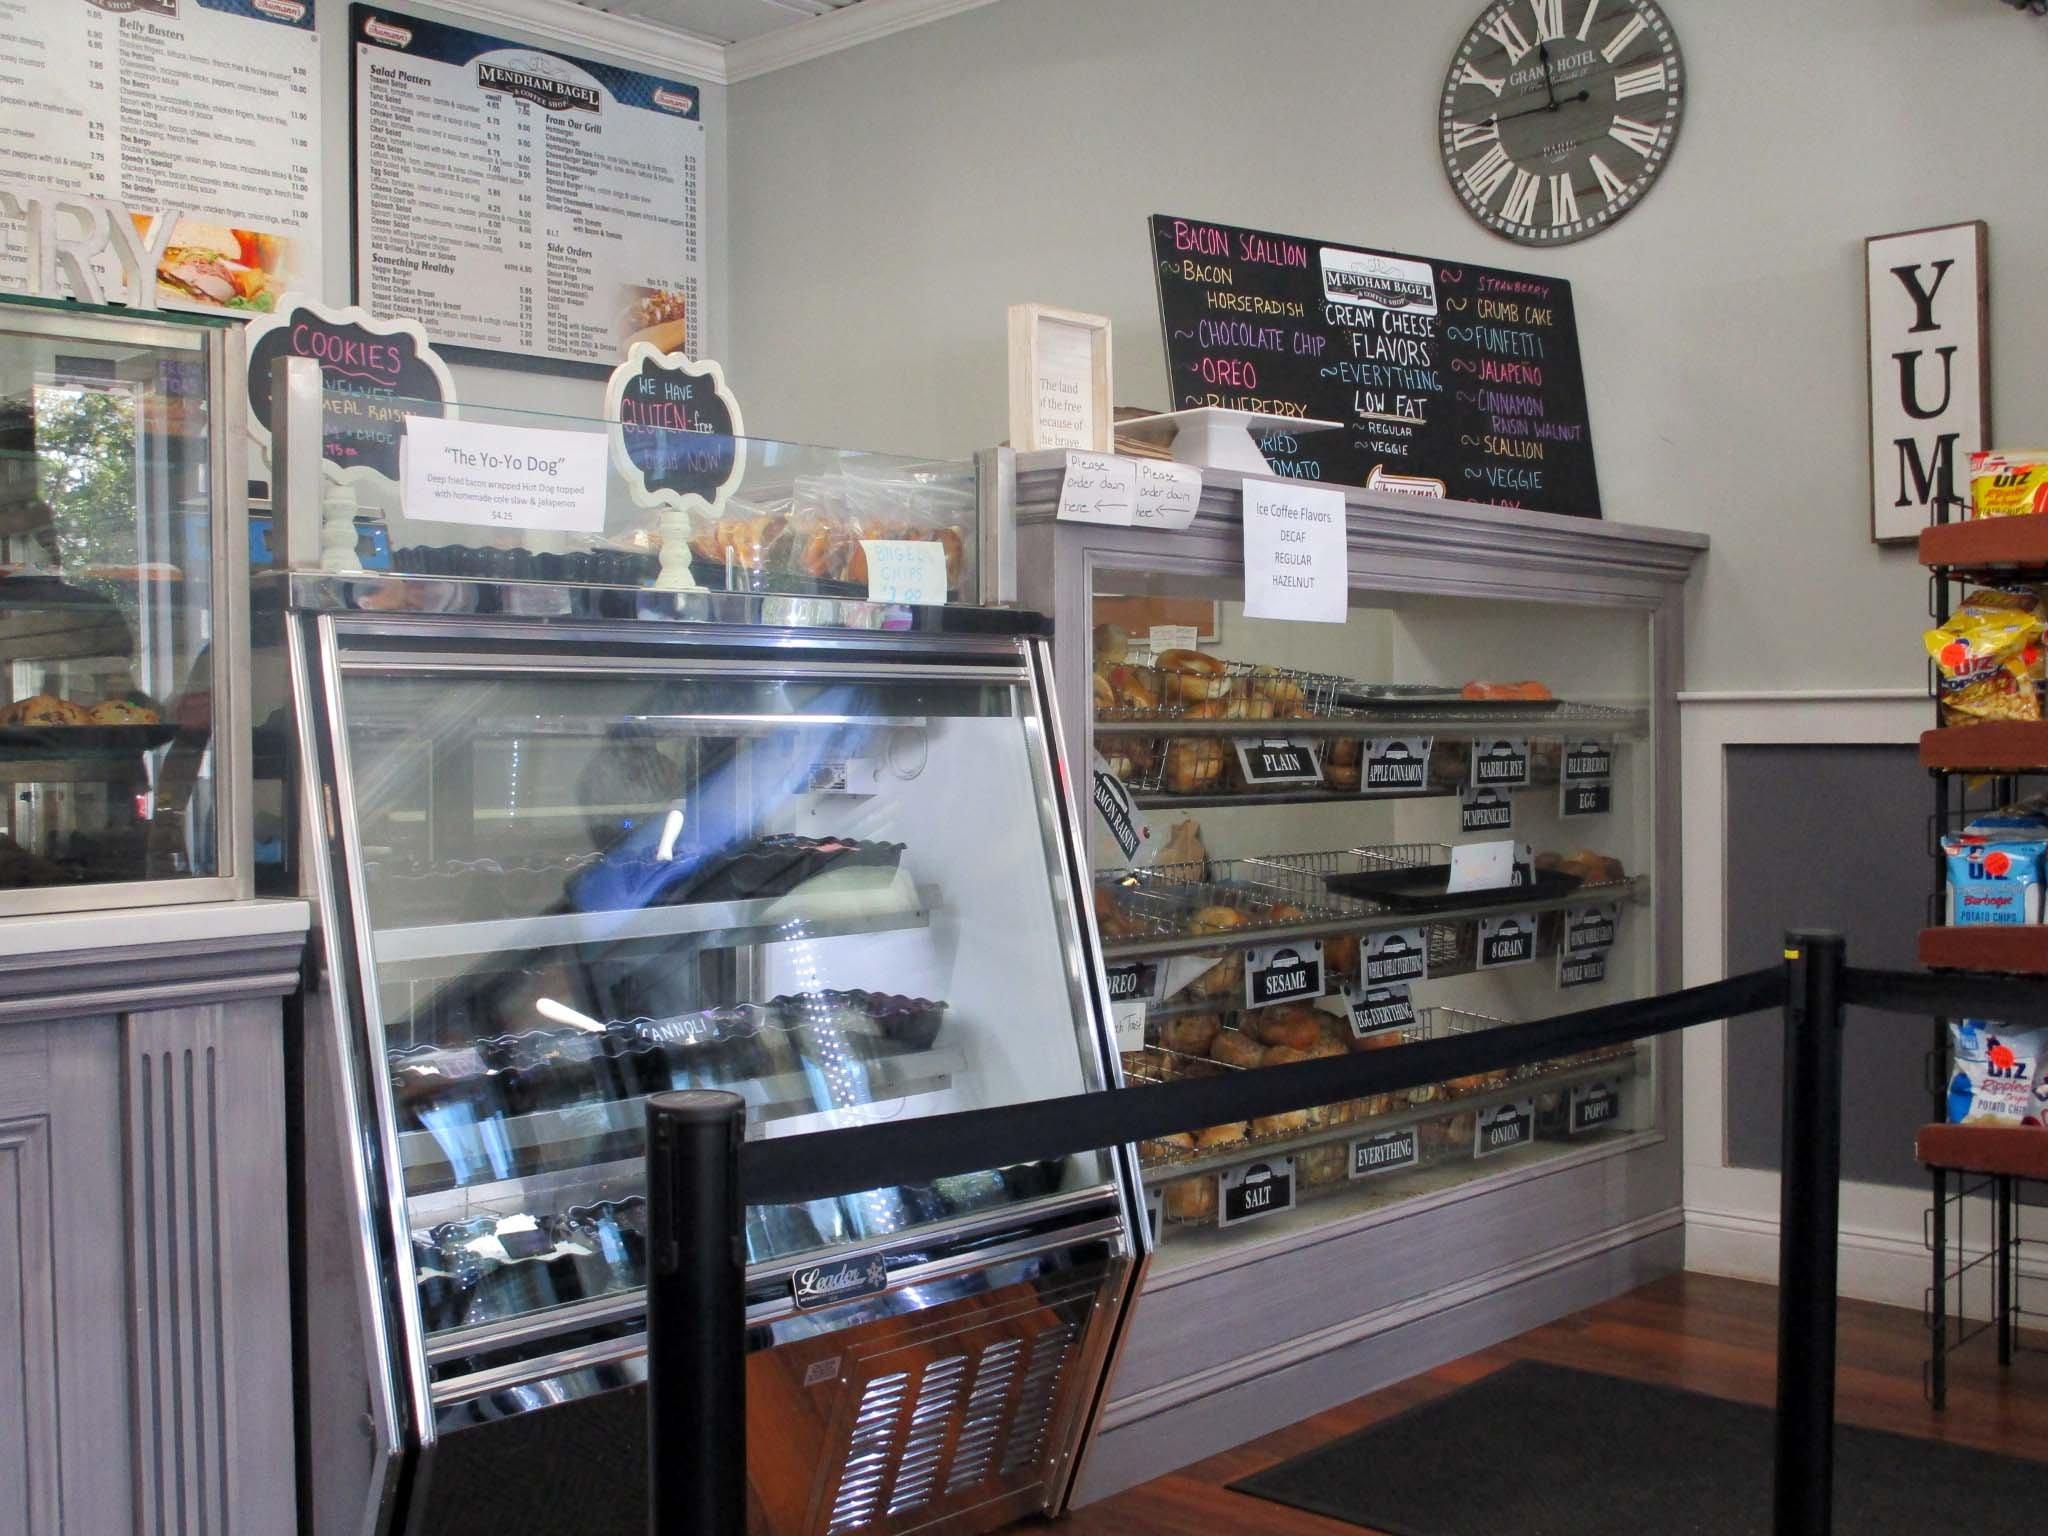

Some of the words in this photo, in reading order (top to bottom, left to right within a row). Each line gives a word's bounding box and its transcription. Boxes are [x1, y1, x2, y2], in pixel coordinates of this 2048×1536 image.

[119, 17, 145, 33] Belly
[149, 24, 185, 41] Busters
[370, 64, 395, 78] Salad
[399, 70, 431, 86] Platters
[1510, 63, 1554, 87] GRAND
[1557, 50, 1597, 72] HOTEL
[480, 65, 553, 92] MENDHAM
[557, 83, 599, 106] BAGEL
[546, 114, 565, 127] From
[568, 119, 582, 129] Our
[585, 122, 601, 134] Grill
[547, 243, 564, 254] Side
[567, 246, 592, 258] Orders
[1173, 221, 1229, 257] BACON
[1240, 233, 1307, 268] SCALLION
[372, 253, 419, 271] Something
[422, 261, 455, 275] Healthy
[1184, 260, 1233, 286] BACON
[1326, 271, 1391, 291] MENDHAM
[1394, 281, 1432, 300] BAGEL
[1207, 291, 1305, 317] HORSERADISH
[1477, 299, 1520, 322] CRUMB
[1525, 306, 1553, 327] CAKE
[1325, 304, 1375, 328] CREAM
[1382, 311, 1435, 338] CHEESE
[1199, 319, 1284, 351] CHOCOLATE
[1293, 332, 1326, 356] CHIP
[1475, 326, 1544, 360] FUNFETTI
[292, 324, 402, 374] COOKIES
[1352, 333, 1431, 367] FLAVORS
[1203, 358, 1257, 389] OREO
[1340, 362, 1443, 392] EVERYTHING
[1890, 259, 1960, 507] YUM
[639, 377, 656, 395] WE
[664, 382, 693, 401] HAVE
[1059, 380, 1078, 394] land
[1048, 397, 1063, 411] the
[1064, 399, 1082, 413] free
[1354, 390, 1385, 412] LOW
[1396, 395, 1428, 419] FAT
[1477, 388, 1544, 418] CINNAMON
[1073, 419, 1083, 431] of
[1368, 421, 1413, 437] REGULAR
[1492, 416, 1529, 436] RAISIN
[1533, 423, 1582, 441] WALNUT
[1370, 441, 1408, 455] VEGGIE
[1483, 435, 1544, 460] SCALLION
[480, 452, 522, 470] Yo-Yo
[1072, 456, 1110, 471] Please
[427, 473, 446, 484] Deep
[465, 477, 486, 487] bacon
[488, 480, 520, 491] wrapped
[522, 482, 537, 492] Hot
[538, 483, 555, 494] Dog
[556, 486, 584, 495] topped
[1067, 478, 1094, 489] order
[1099, 477, 1126, 492] down
[1142, 465, 1178, 483] Please
[1486, 467, 1543, 490] VEGGIE
[511, 496, 529, 505] slaw
[1140, 487, 1164, 498] order
[1166, 489, 1191, 503] down
[1064, 502, 1090, 513] here
[1256, 502, 1269, 516] Ice
[1270, 503, 1299, 520] Coffee
[1300, 508, 1332, 524] Flavors
[1280, 530, 1306, 543] DECAF
[1275, 552, 1312, 567] REGULAR
[1272, 575, 1315, 589] HAZELNUT
[1262, 753, 1301, 773] PLAIN
[1368, 764, 1388, 782] APPLE
[1389, 763, 1423, 781] CINNAMON
[1480, 761, 1508, 778] MARBLE
[1509, 760, 1524, 776] RYE
[1579, 793, 1596, 809] EGG
[1463, 807, 1510, 826] PUMPERNICKEL
[1113, 812, 1137, 853] RAISIN
[1961, 912, 1990, 921] POTATO
[1993, 912, 2017, 922] CHIPS
[1498, 938, 1524, 957] GRAIN
[1266, 970, 1307, 995] SESAME
[1355, 1008, 1373, 1028] EGG
[1371, 1002, 1413, 1025] EVERYTHING
[641, 1018, 707, 1041] CANNOLI
[1981, 1080, 2032, 1095] Ripples
[1978, 1100, 2005, 1113] POTATO
[1490, 1122, 1521, 1146] ONION
[1357, 1139, 1412, 1167] EVERYTHING
[1244, 1185, 1272, 1209] SALT
[798, 1264, 860, 1294] Leader
